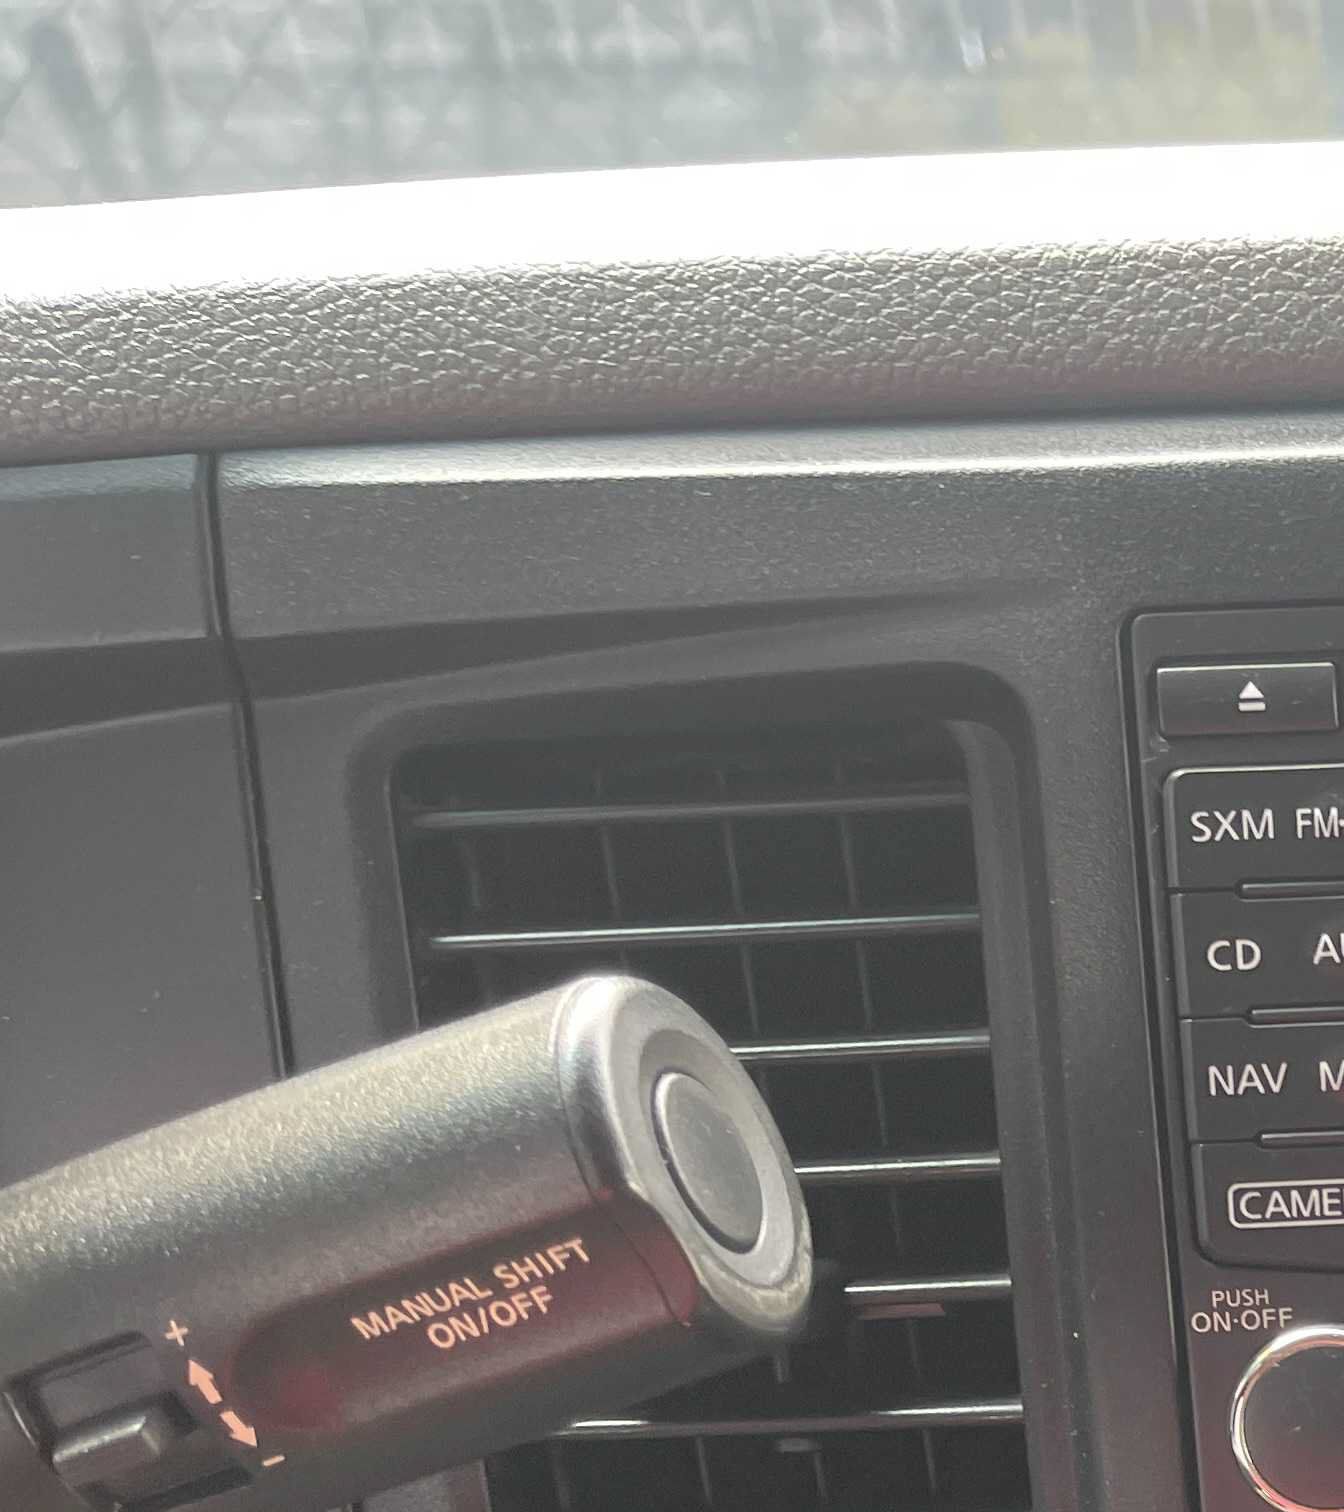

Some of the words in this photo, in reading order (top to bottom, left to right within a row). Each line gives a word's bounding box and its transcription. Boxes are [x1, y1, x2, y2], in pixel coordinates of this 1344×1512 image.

[1190, 808, 1275, 842] SXM
[1206, 939, 1262, 971] CD
[1207, 1062, 1287, 1096] NAV
[351, 1276, 493, 1342] MANUAL
[492, 1237, 591, 1291] SHIFT
[1211, 1288, 1269, 1308] PUSH
[427, 1284, 554, 1350] ON/OFF
